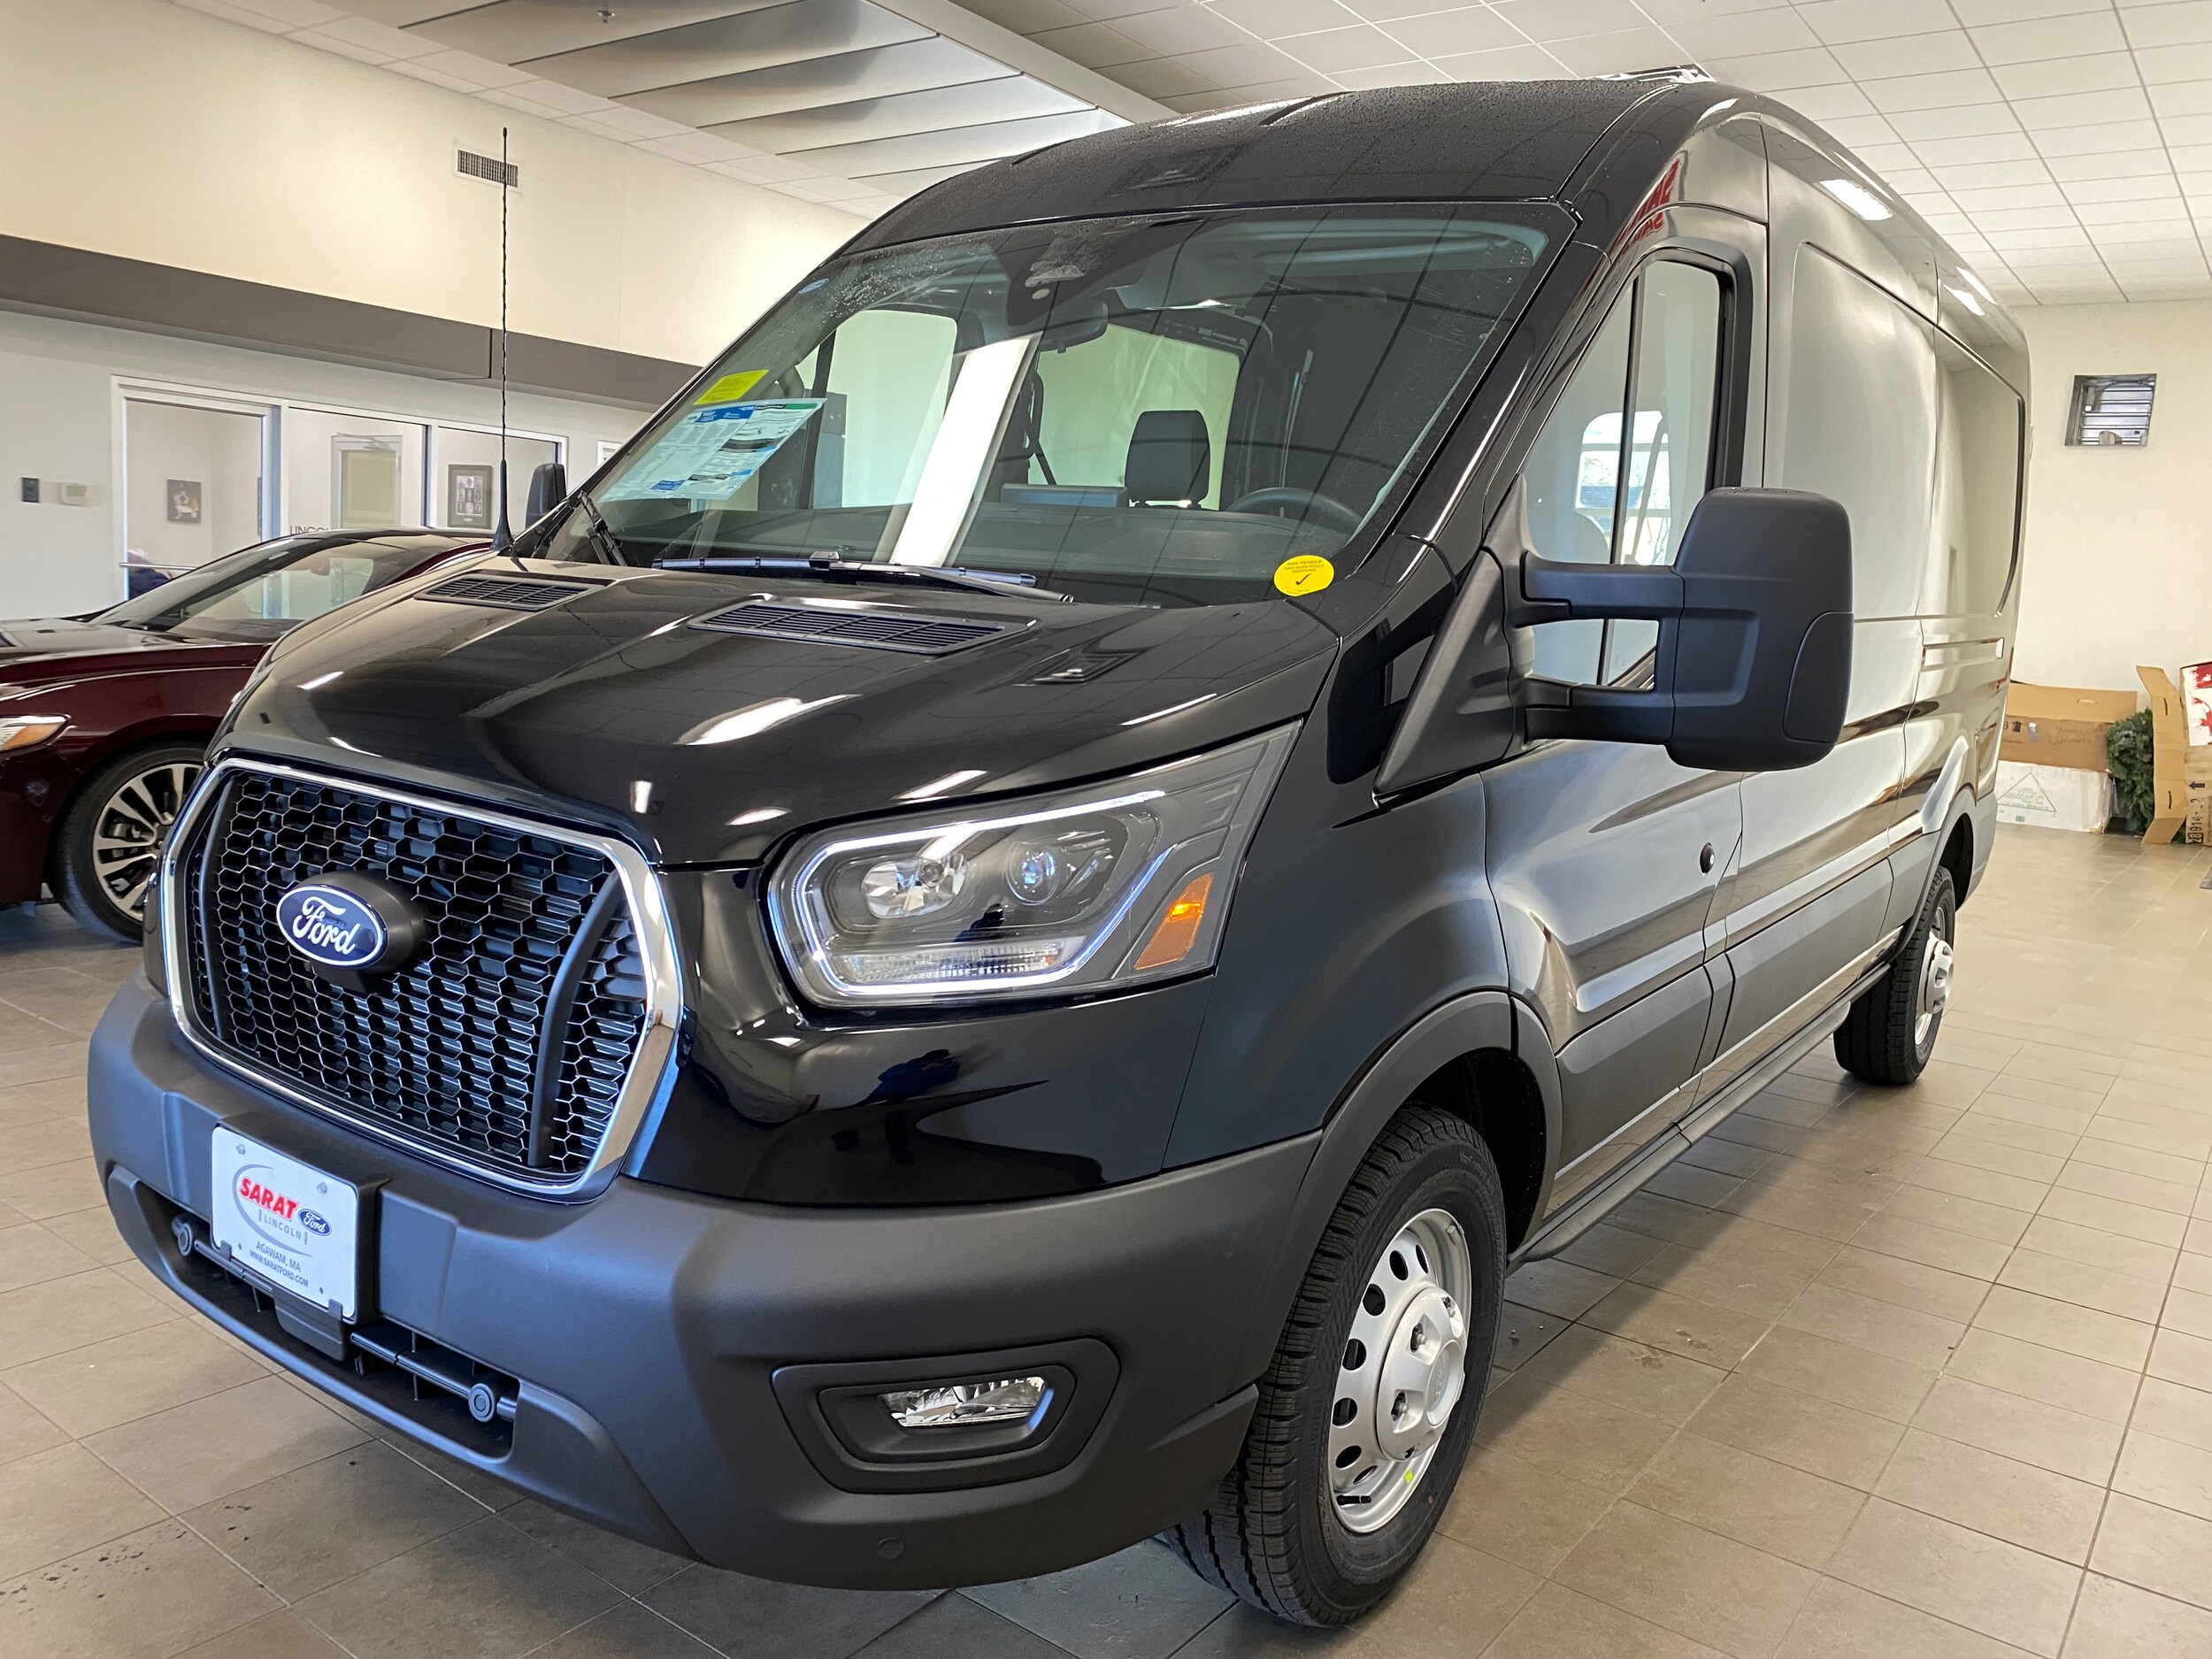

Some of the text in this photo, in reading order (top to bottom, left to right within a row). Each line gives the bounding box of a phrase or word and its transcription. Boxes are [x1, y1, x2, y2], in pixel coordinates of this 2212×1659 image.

[292, 896, 357, 955] Ford
[239, 1177, 326, 1233] SARAT Ford
[264, 1214, 302, 1240] LINCOLN
[249, 1248, 309, 1287] WWW.SARATFORD.COM
[256, 1240, 302, 1273] AGAWAM, MA
